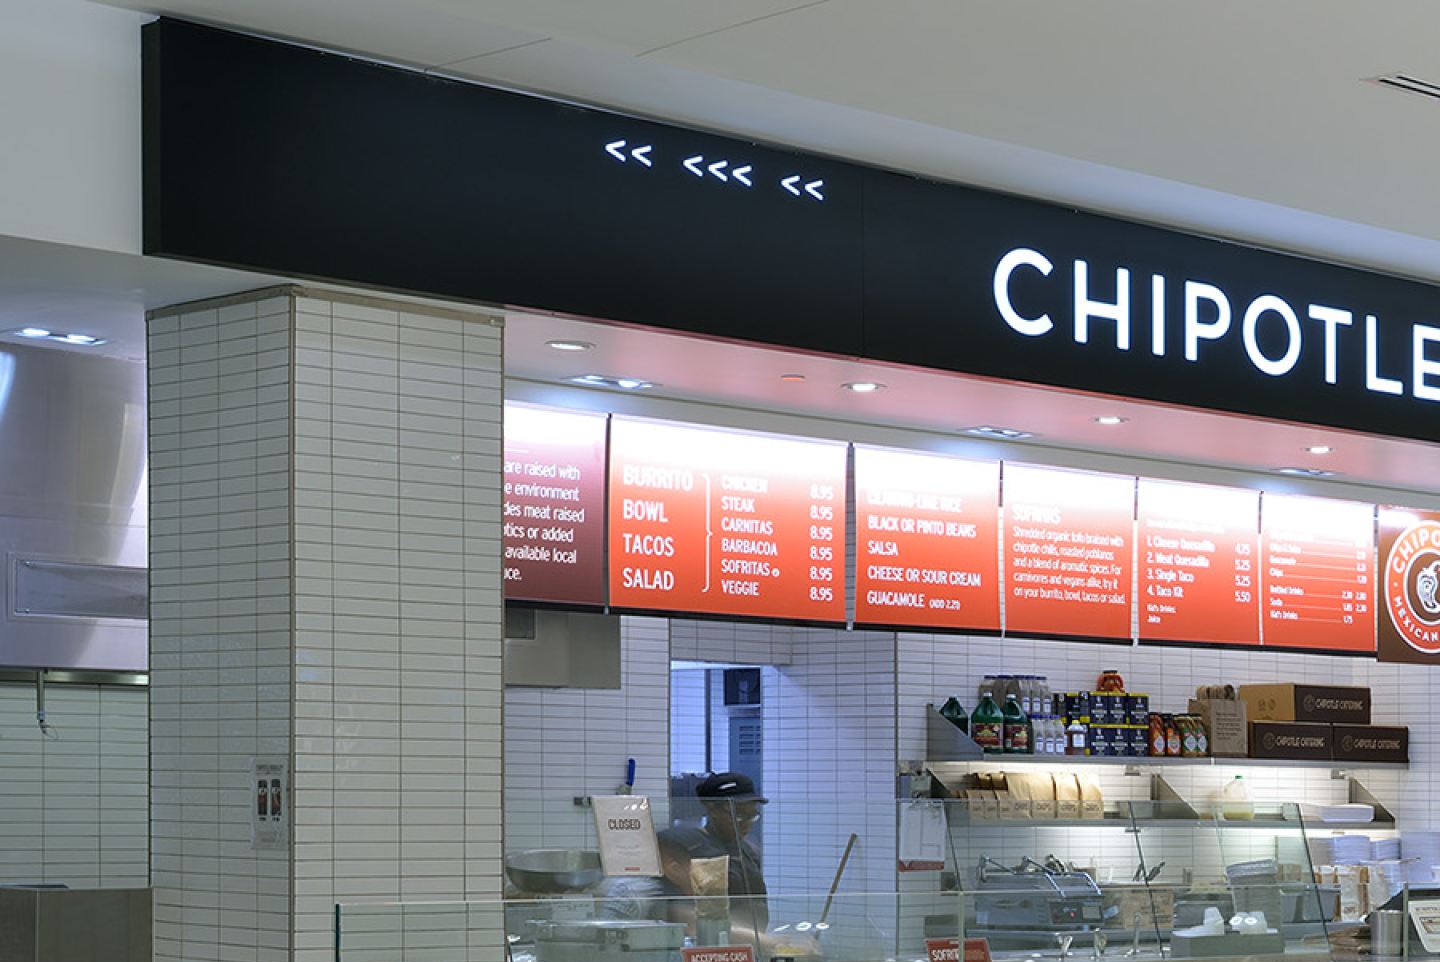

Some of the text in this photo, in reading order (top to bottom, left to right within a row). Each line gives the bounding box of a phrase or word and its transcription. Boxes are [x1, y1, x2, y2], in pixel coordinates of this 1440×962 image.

[524, 461, 557, 478] raised
[558, 464, 581, 481] with
[623, 463, 694, 491] BURRITO
[514, 482, 580, 502] environment
[721, 474, 833, 501] CHICKEN 8.95
[524, 505, 551, 520] meat
[553, 506, 585, 523] raised
[623, 499, 668, 523] BOWL
[721, 496, 833, 521] STEAK 8.95
[527, 527, 539, 539] or
[541, 526, 574, 543] added
[721, 517, 833, 541] CARNITAS 8.95
[868, 515, 977, 539] BLACK OR PINTO BEANS
[505, 545, 577, 564] available local
[622, 533, 675, 557] TACOS
[721, 538, 833, 561] BARBACOA 8.95
[868, 540, 899, 556] SALSA
[622, 567, 675, 591] SALAD
[721, 559, 833, 582] SOFRITAS 8.95
[867, 565, 982, 588] CHEESE OR SOUR CREAM
[721, 580, 833, 602] VEGGIE 8.95
[867, 590, 925, 608] GUACAMOLE
[1393, 596, 1439, 642] MEXICAN
[608, 818, 641, 831] CLOSED
[730, 951, 748, 962] CASH
